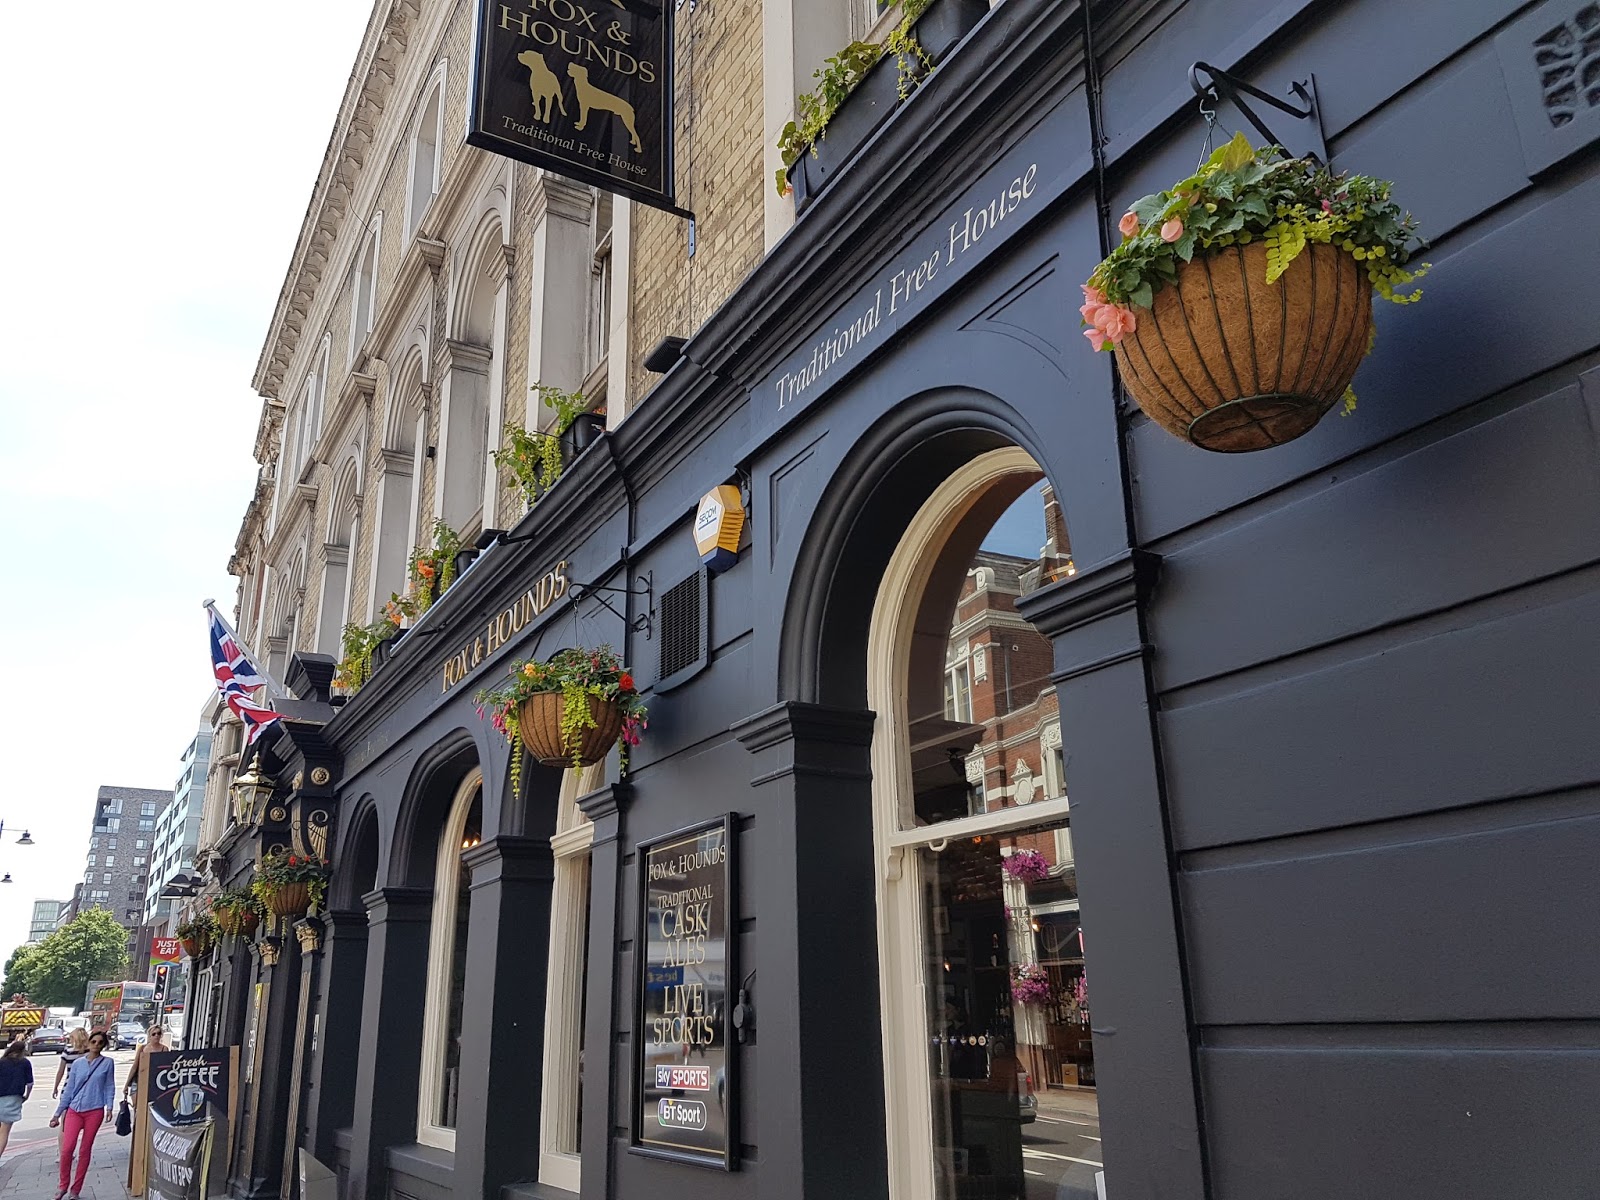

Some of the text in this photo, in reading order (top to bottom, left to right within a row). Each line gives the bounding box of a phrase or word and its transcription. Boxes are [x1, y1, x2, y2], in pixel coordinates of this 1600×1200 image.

[498, 4, 656, 83] HOUNDS
[607, 20, 631, 45] &
[502, 115, 647, 176] Traditional Free House
[775, 163, 1037, 412] Traditional Free House
[441, 560, 569, 694] FOX & HOUNDS
[648, 845, 726, 881] FOX & HOUNDS
[658, 884, 713, 910] TRADITIONAL
[661, 902, 708, 938] CASK
[156, 940, 178, 948] JUST
[662, 934, 706, 968] ALES
[664, 983, 703, 1014] LIVE
[653, 1015, 714, 1045] SPORTS
[172, 1054, 207, 1071] fresh
[658, 1067, 707, 1086] sky SPORTS
[156, 1066, 219, 1090] COFFEE
[663, 1104, 701, 1125] BT Sport
